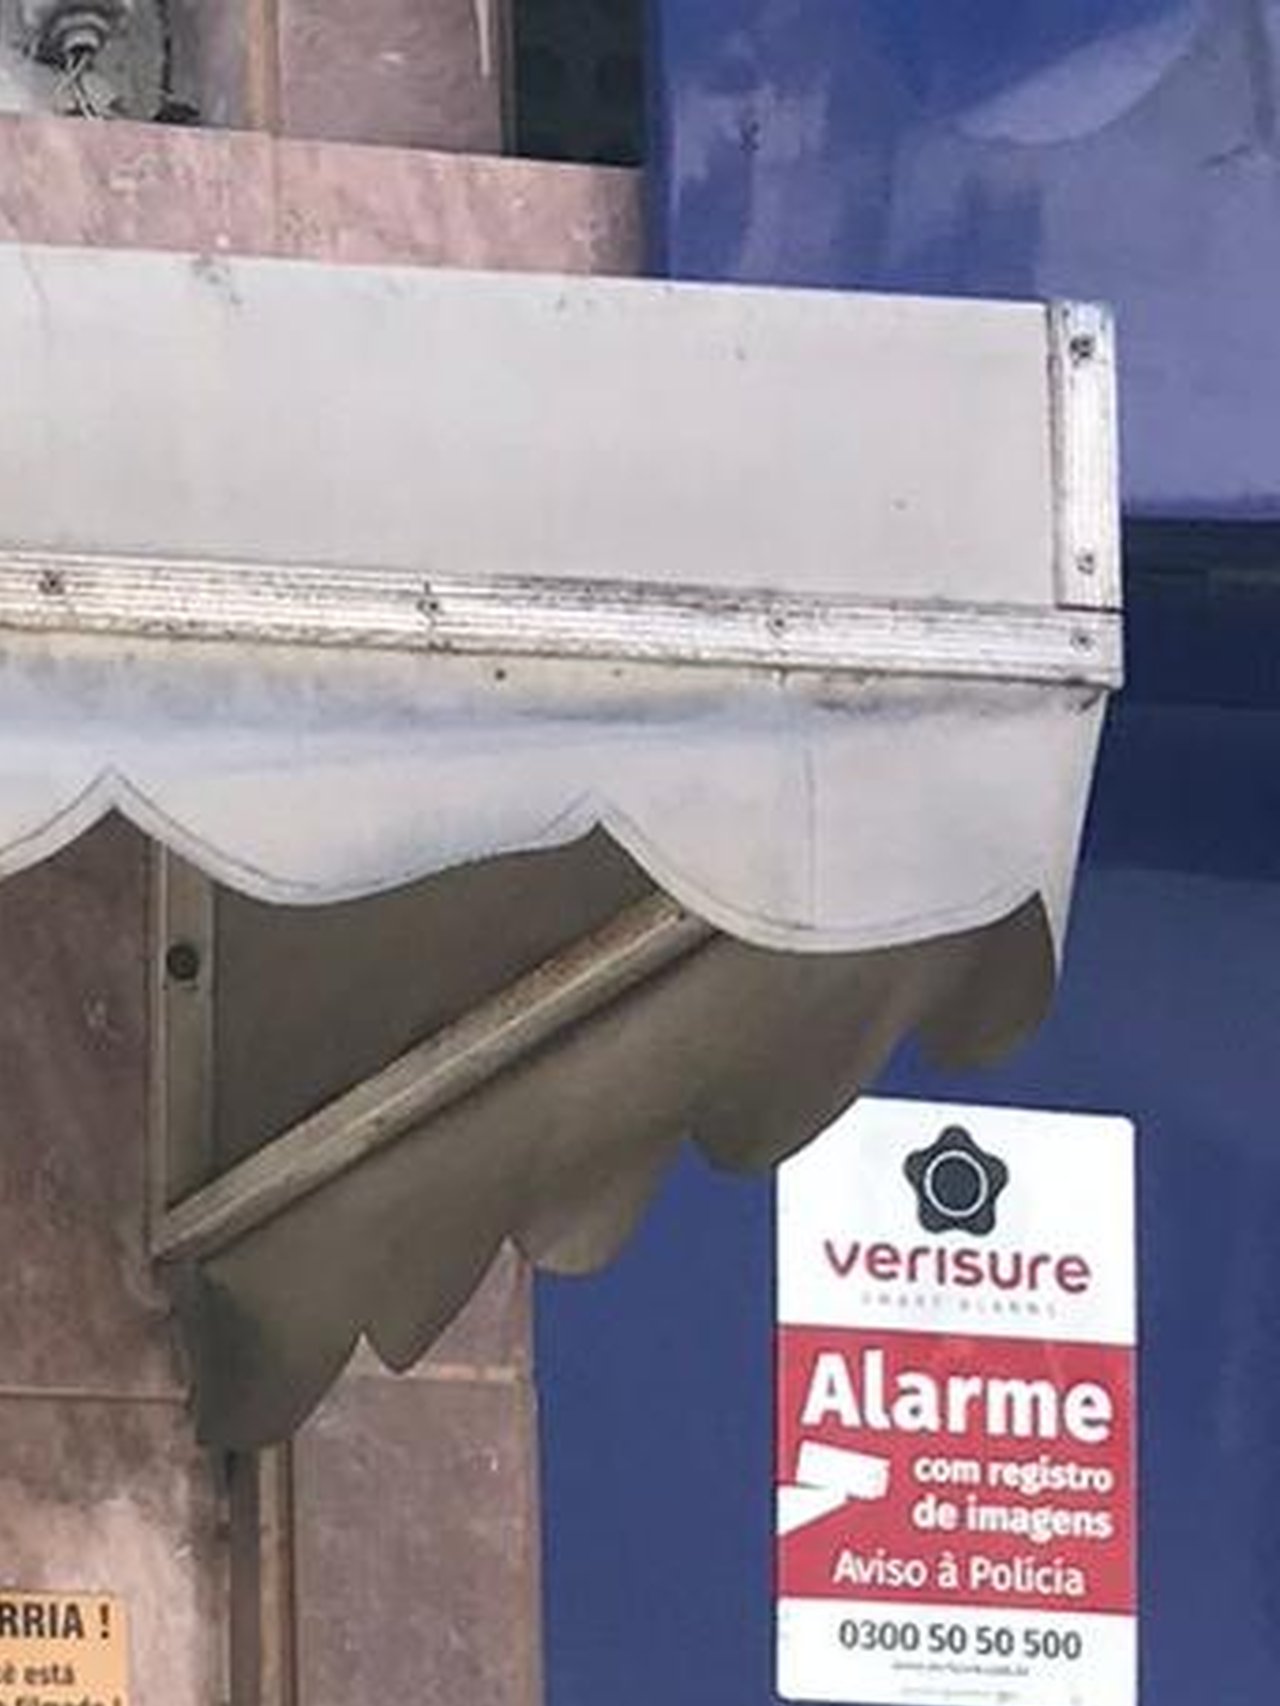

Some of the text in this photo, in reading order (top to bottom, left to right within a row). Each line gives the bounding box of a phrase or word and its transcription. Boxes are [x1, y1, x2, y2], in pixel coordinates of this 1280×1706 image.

[824, 1238, 1092, 1294] verisure
[801, 1349, 1113, 1443] Alarme
[914, 1455, 1114, 1495] com registro
[913, 1494, 1114, 1543] de imagens
[833, 1549, 927, 1587] Aviso
[970, 1557, 1085, 1595] Polícia
[838, 1619, 1083, 1660] 0300 50 50 500
[23, 1662, 75, 1685] está
